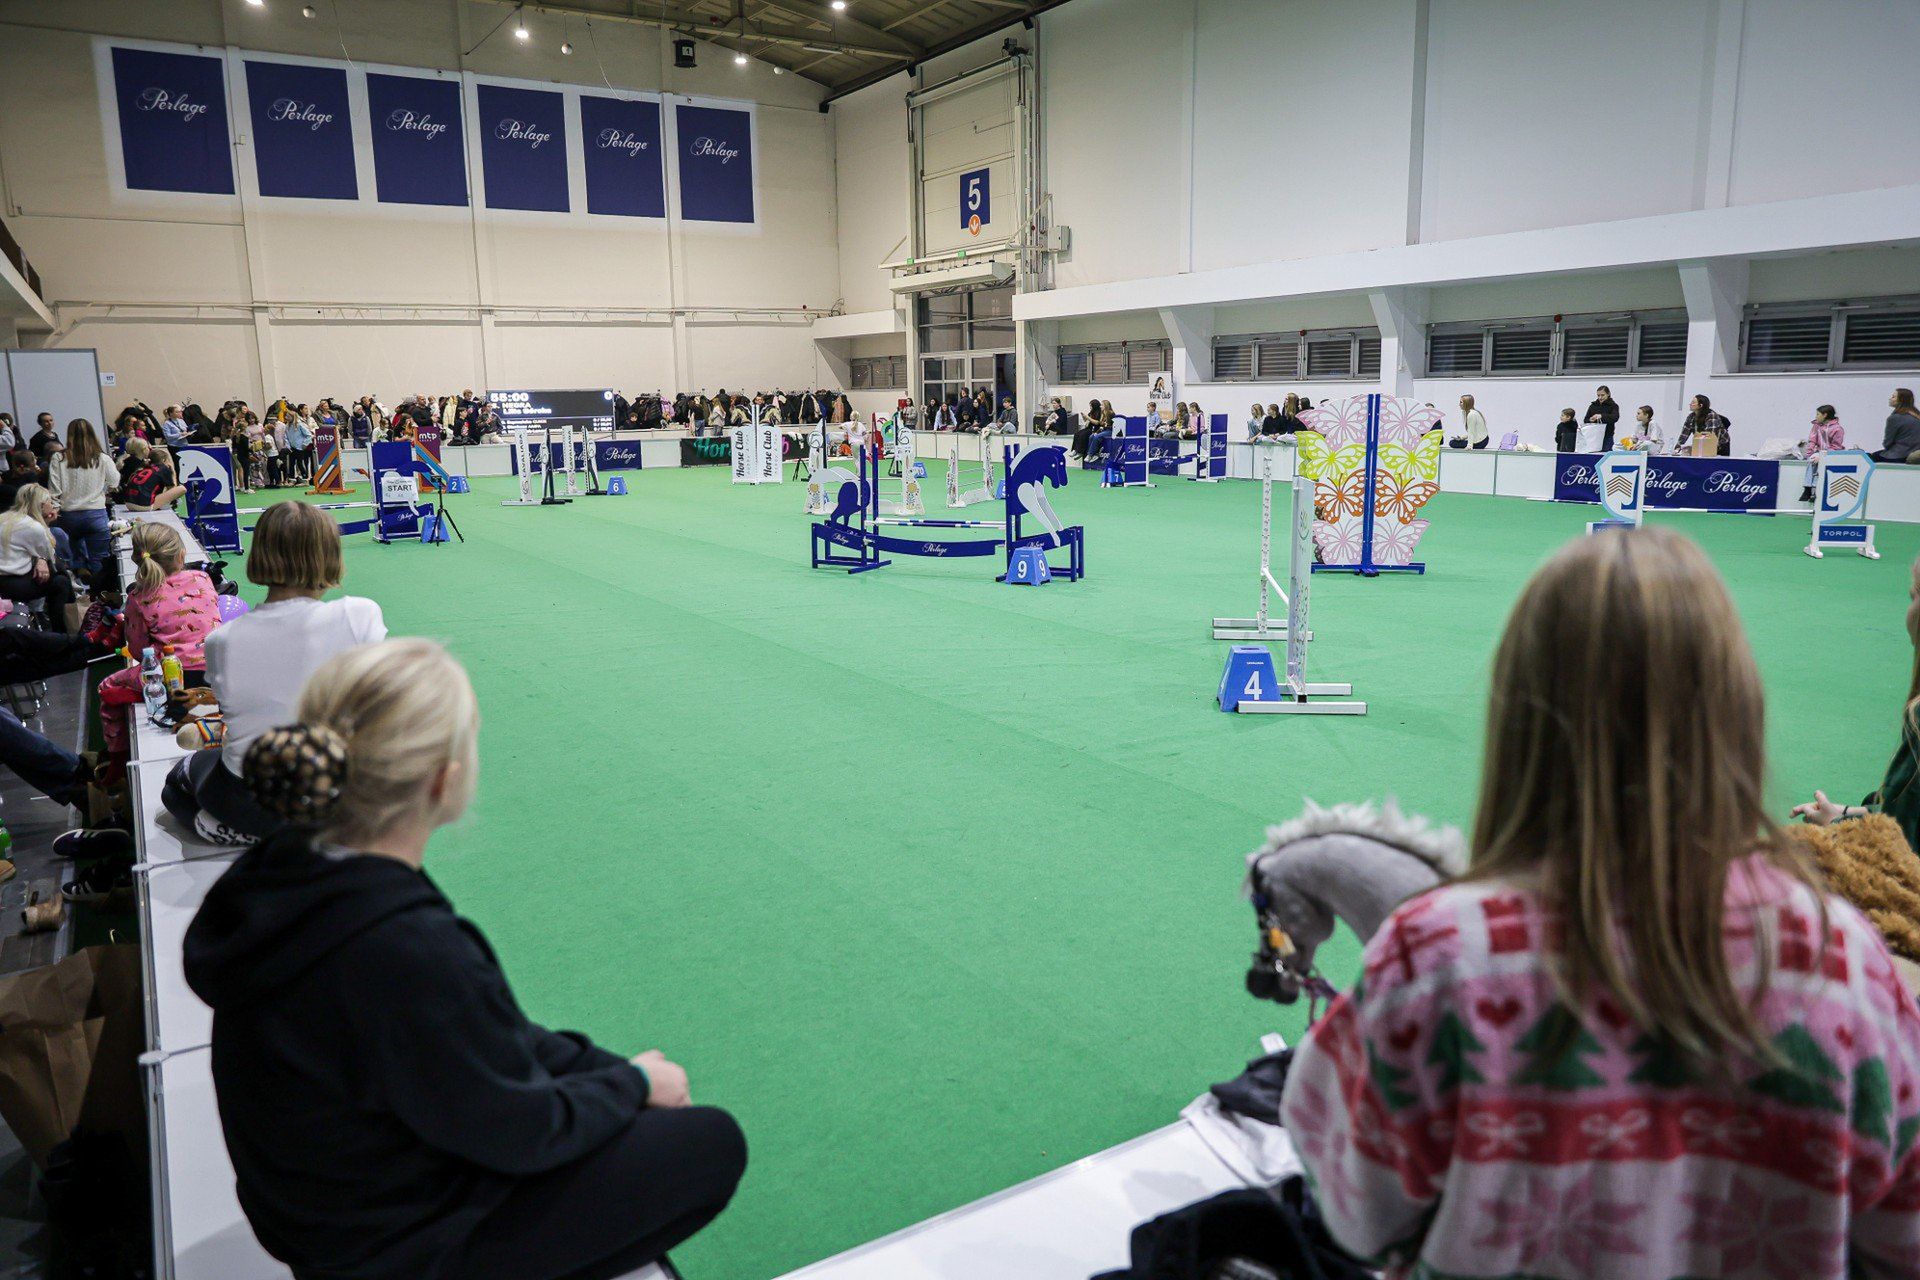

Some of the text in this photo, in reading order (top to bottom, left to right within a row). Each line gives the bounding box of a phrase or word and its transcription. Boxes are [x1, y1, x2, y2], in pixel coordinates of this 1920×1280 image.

[136, 87, 207, 122] Perlage
[267, 98, 333, 131] Perlage
[385, 108, 447, 140] Perlage
[494, 118, 551, 149] Perlage
[596, 127, 648, 157] Perlage
[690, 136, 739, 164] Perlage
[967, 177, 982, 211] 5
[419, 432, 437, 440] mtp
[693, 437, 731, 458] Hor
[735, 431, 744, 478] Horse Club
[763, 431, 772, 478] Horse Club
[451, 481, 457, 491] 2
[613, 482, 619, 492] 6
[1561, 464, 1601, 494] Perla
[1703, 470, 1767, 502] Perlage
[1017, 560, 1028, 579] 9
[1038, 559, 1046, 577] 9
[1243, 670, 1263, 701] 4
